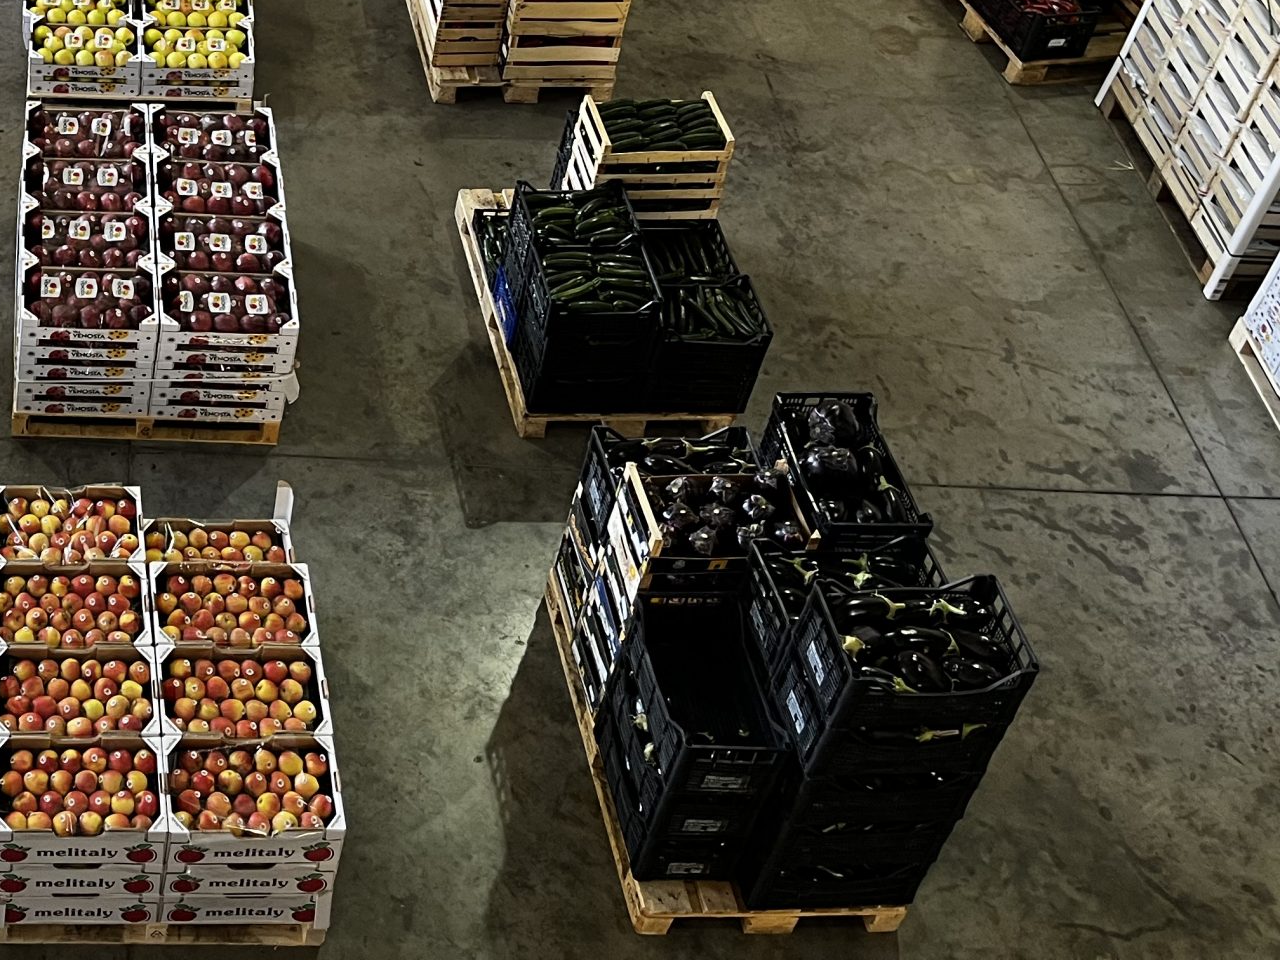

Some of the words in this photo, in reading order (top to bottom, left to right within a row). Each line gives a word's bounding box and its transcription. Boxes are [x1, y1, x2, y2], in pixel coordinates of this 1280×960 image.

[36, 846, 118, 859] melitaly
[213, 845, 295, 859] melitaly
[35, 877, 116, 890] melitaly
[208, 877, 289, 889] melitaly
[34, 906, 113, 919] melitaly
[205, 906, 284, 919] melitaly
